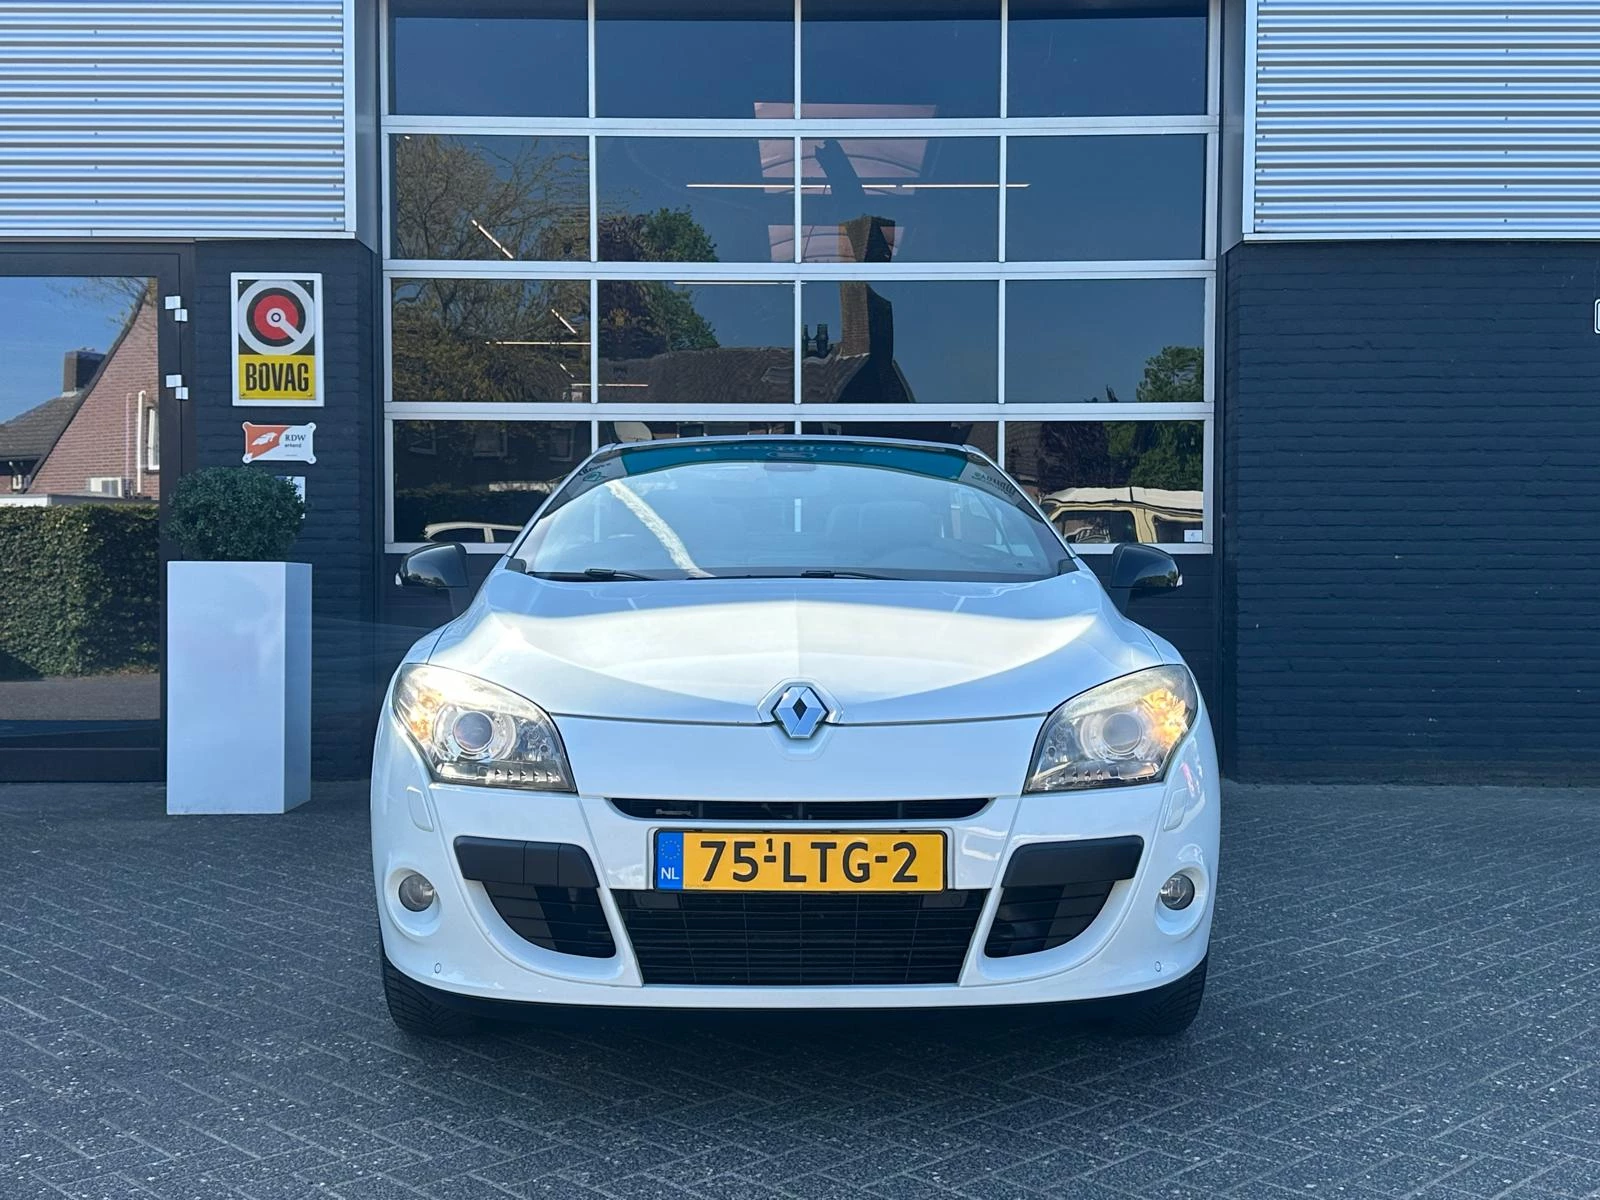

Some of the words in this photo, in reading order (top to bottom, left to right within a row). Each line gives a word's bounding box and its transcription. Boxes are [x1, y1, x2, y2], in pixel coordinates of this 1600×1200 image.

[245, 362, 309, 392] BOVAG
[284, 433, 306, 442] RDW
[660, 867, 680, 880] NL
